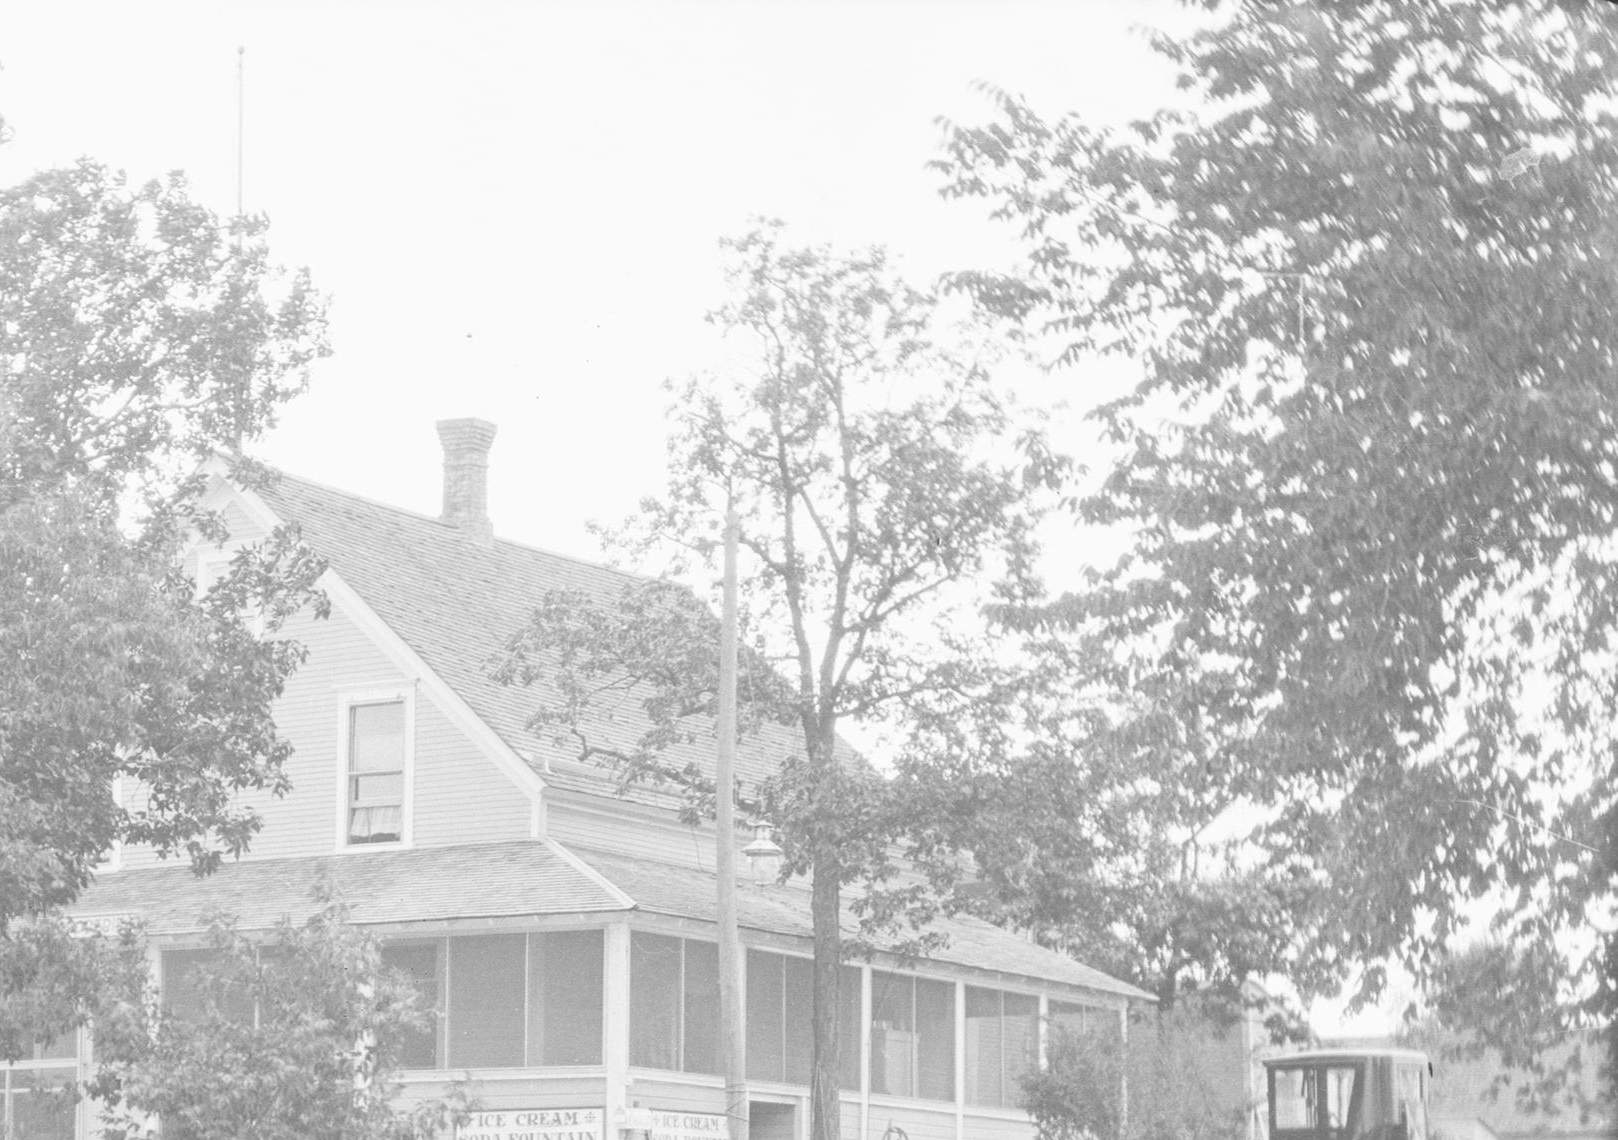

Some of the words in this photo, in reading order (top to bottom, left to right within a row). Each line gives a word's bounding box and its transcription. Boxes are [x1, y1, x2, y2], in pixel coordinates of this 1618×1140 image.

[479, 1113, 506, 1127] ICE
[515, 1111, 579, 1126] CREAM
[663, 1114, 679, 1128] ICE
[683, 1116, 718, 1131] CREAM
